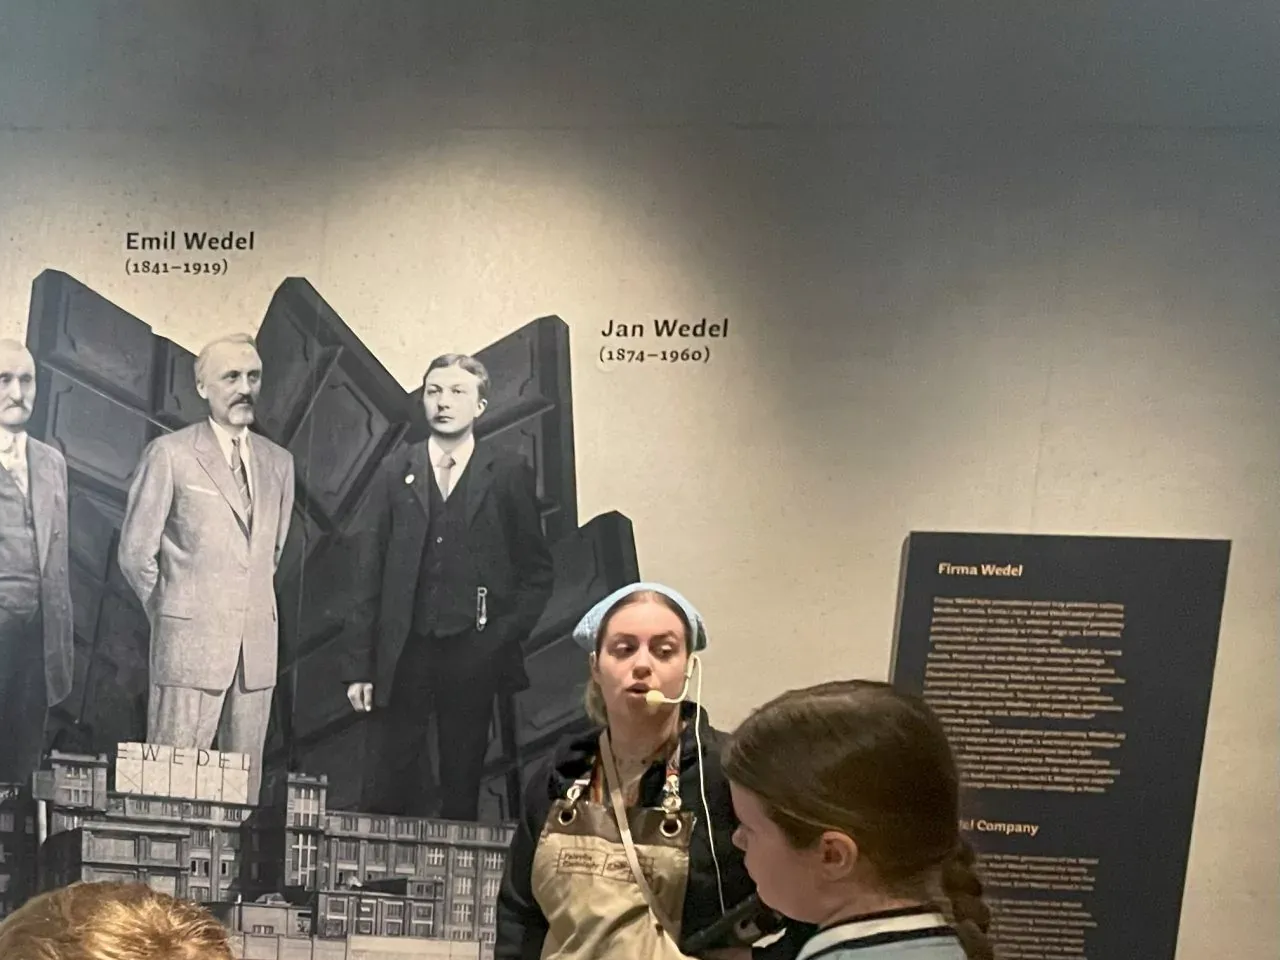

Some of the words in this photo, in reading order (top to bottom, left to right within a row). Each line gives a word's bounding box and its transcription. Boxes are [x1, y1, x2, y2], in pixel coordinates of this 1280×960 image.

[126, 230, 175, 250] Emil
[183, 230, 255, 250] Wedel
[601, 319, 644, 337] Jan
[653, 317, 729, 338] Wedel
[938, 562, 978, 575] Firma
[980, 563, 1024, 577] Wedel
[976, 819, 1040, 836] Company
